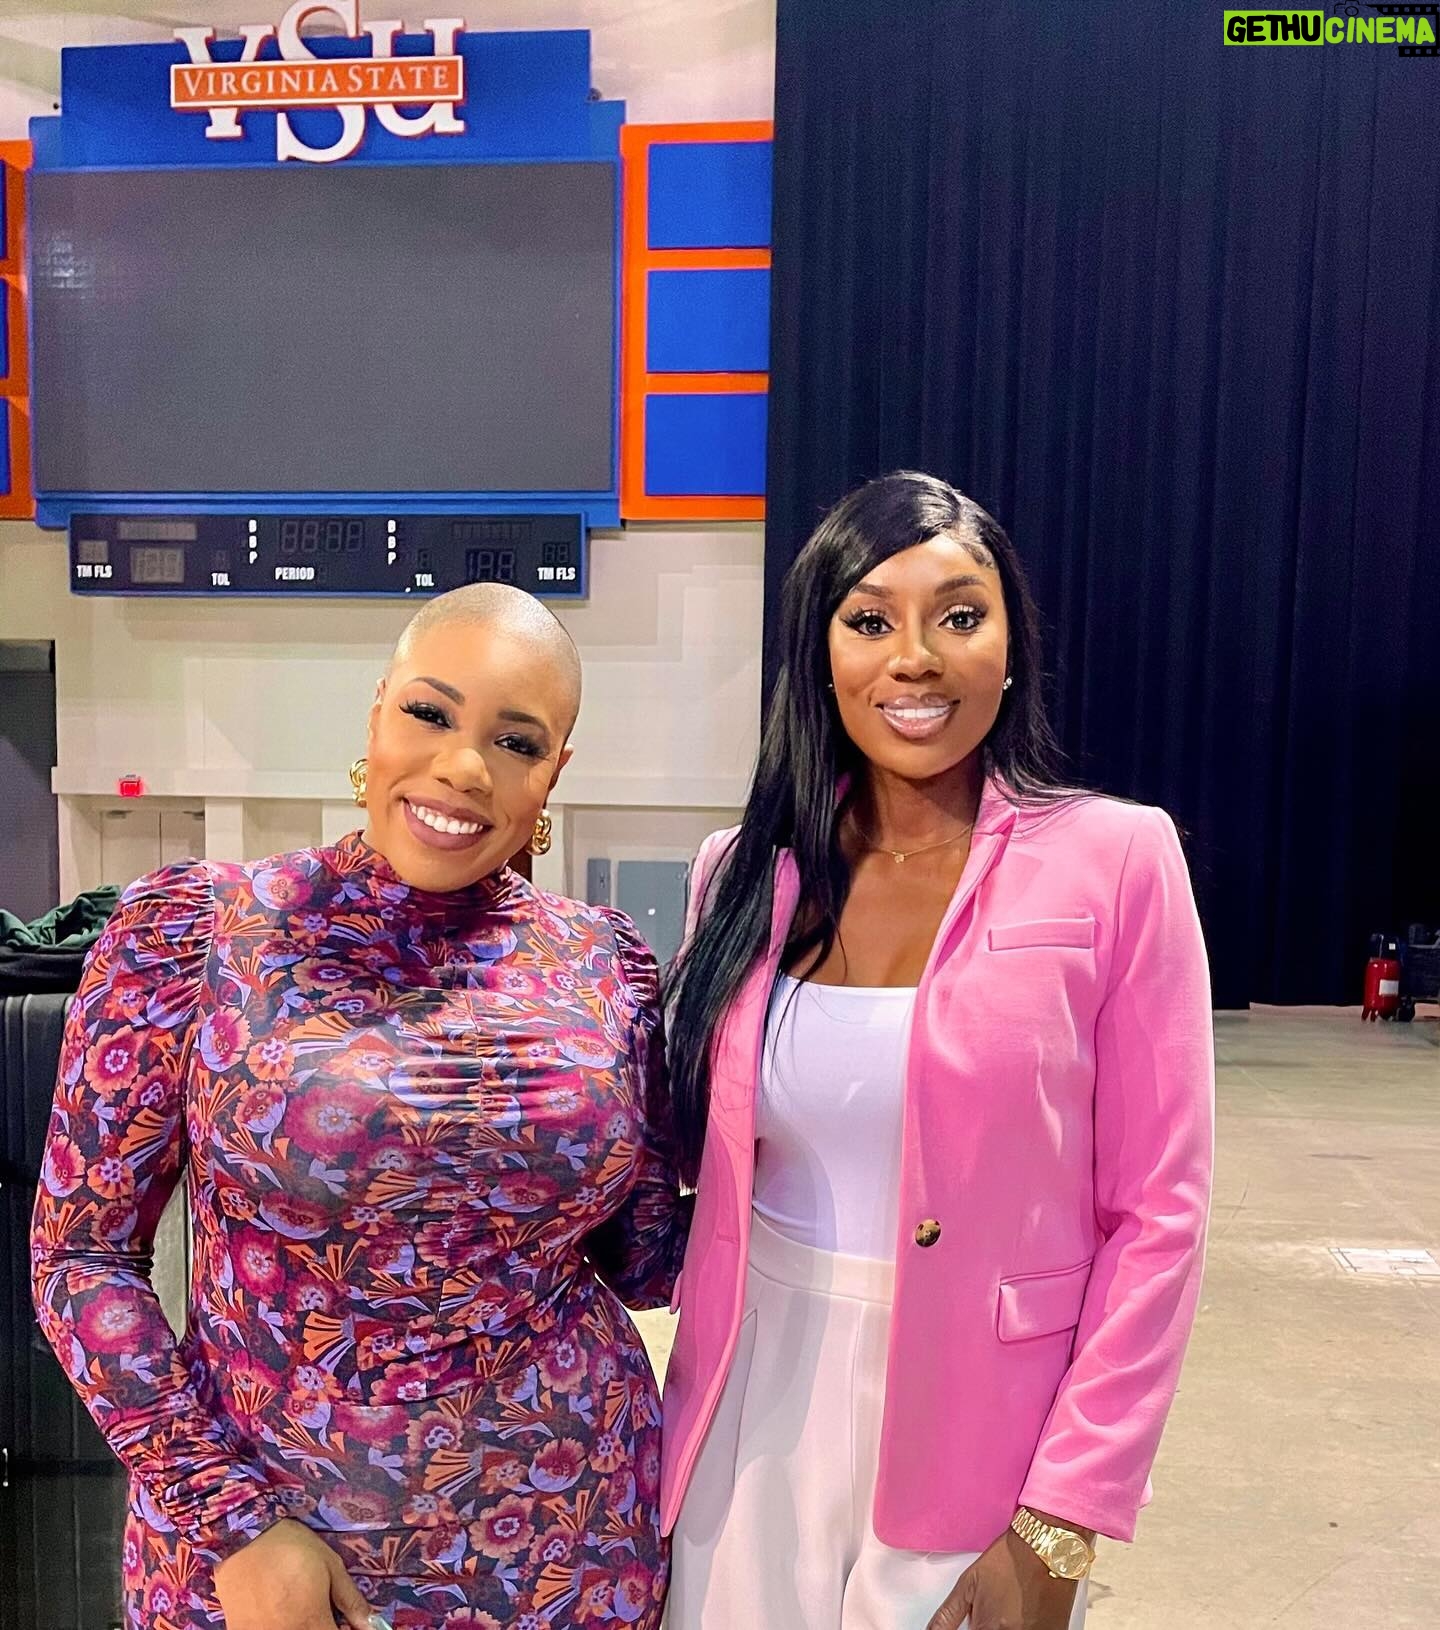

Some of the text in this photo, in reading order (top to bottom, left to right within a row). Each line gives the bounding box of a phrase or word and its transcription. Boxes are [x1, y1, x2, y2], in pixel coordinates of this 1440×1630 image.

[182, 65, 450, 97] VIRGINIA STATE
[211, 572, 231, 587] TOL
[274, 566, 315, 581] PERIOD
[414, 573, 435, 587] TOL
[554, 567, 576, 581] FLS
